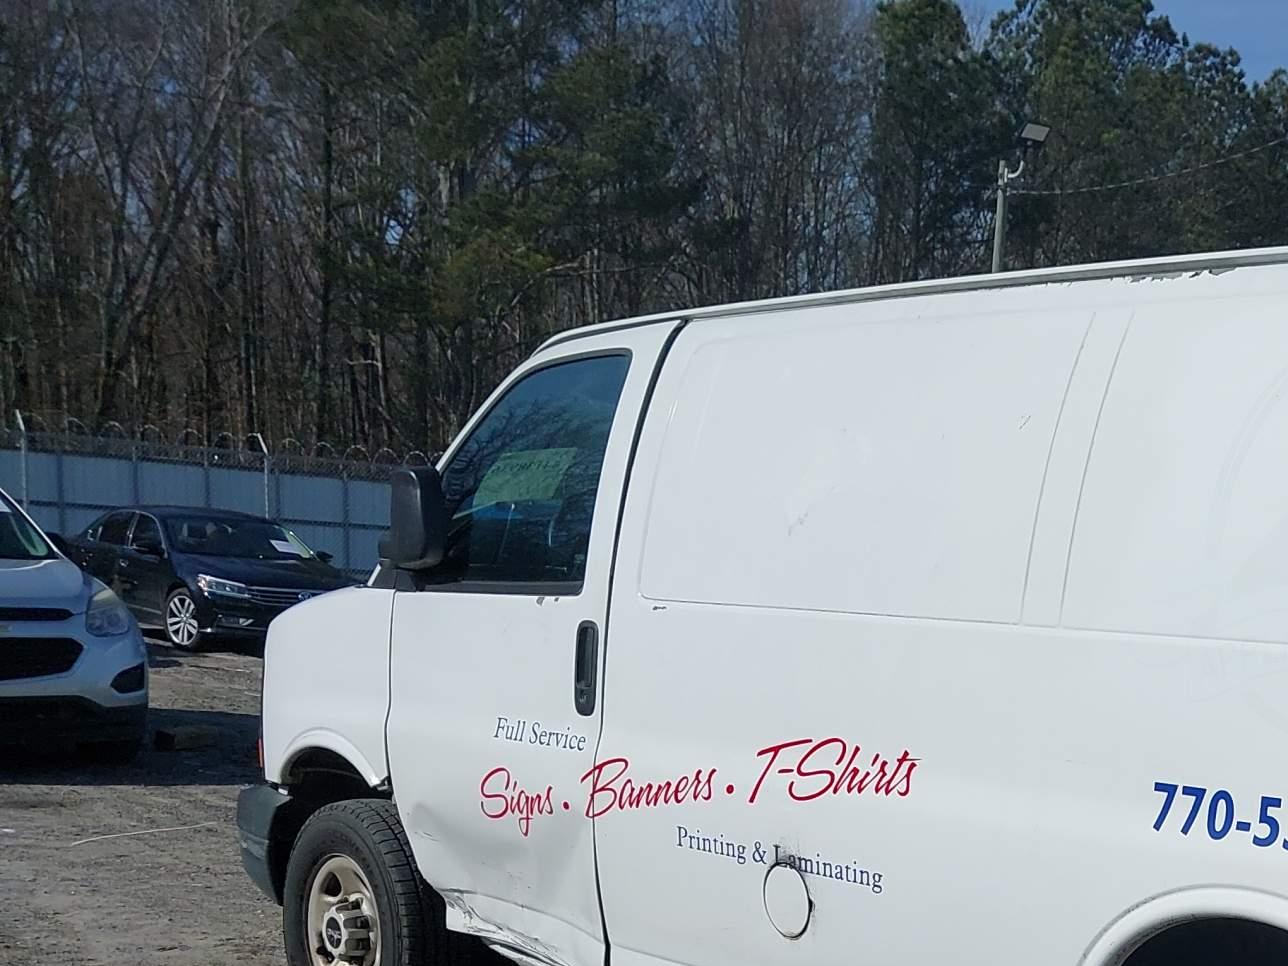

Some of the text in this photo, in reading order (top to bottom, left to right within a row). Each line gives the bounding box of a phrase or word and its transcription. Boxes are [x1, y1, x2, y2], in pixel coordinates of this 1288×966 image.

[493, 717, 587, 751] Full Service
[481, 767, 553, 836] Signs
[580, 758, 717, 818] Banners
[748, 738, 922, 803] T-Shirts
[677, 826, 883, 894] Printing & Laminating
